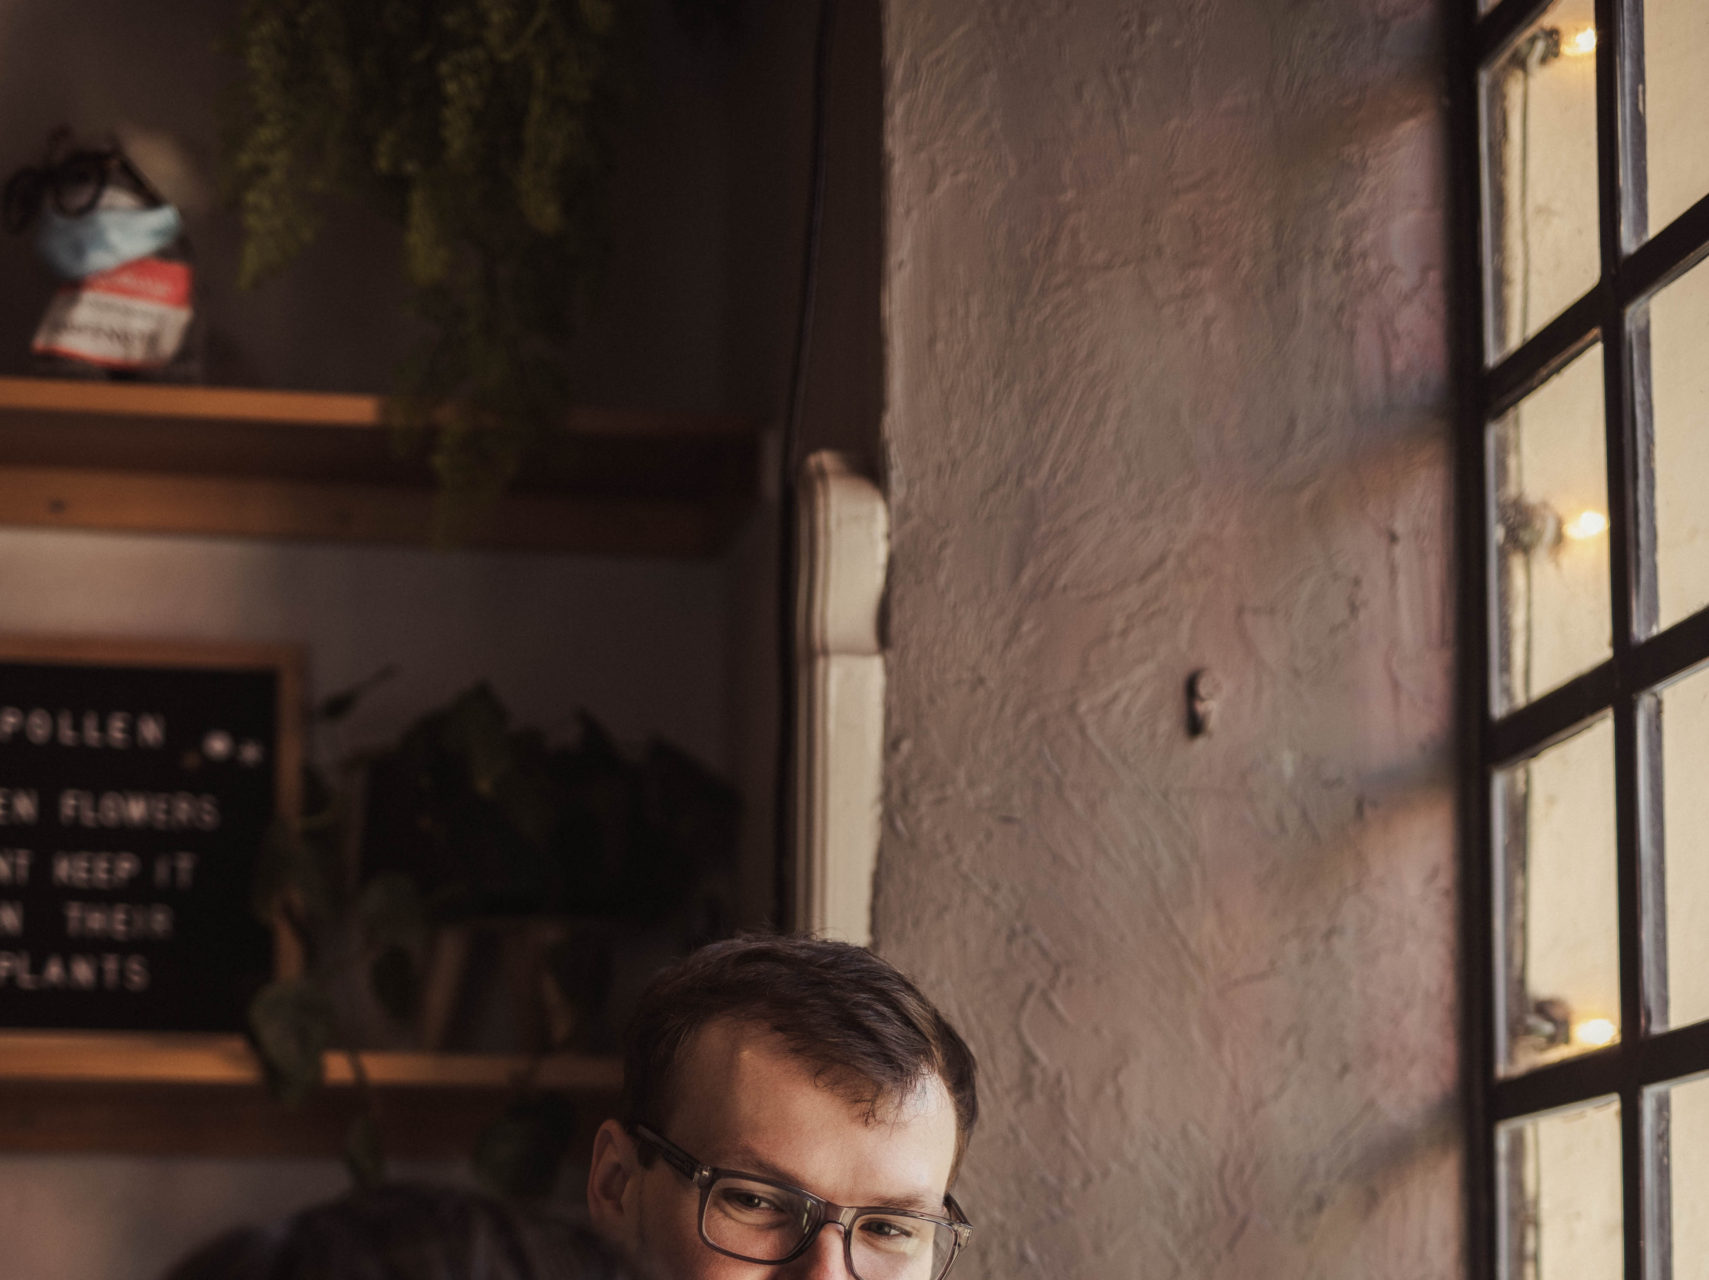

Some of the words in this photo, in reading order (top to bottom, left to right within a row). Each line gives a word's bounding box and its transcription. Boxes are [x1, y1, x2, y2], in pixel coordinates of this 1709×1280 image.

[0, 707, 166, 748] POLLEN
[60, 790, 221, 831] FLOWERS
[53, 852, 141, 889] KEEP
[154, 852, 199, 889] IT
